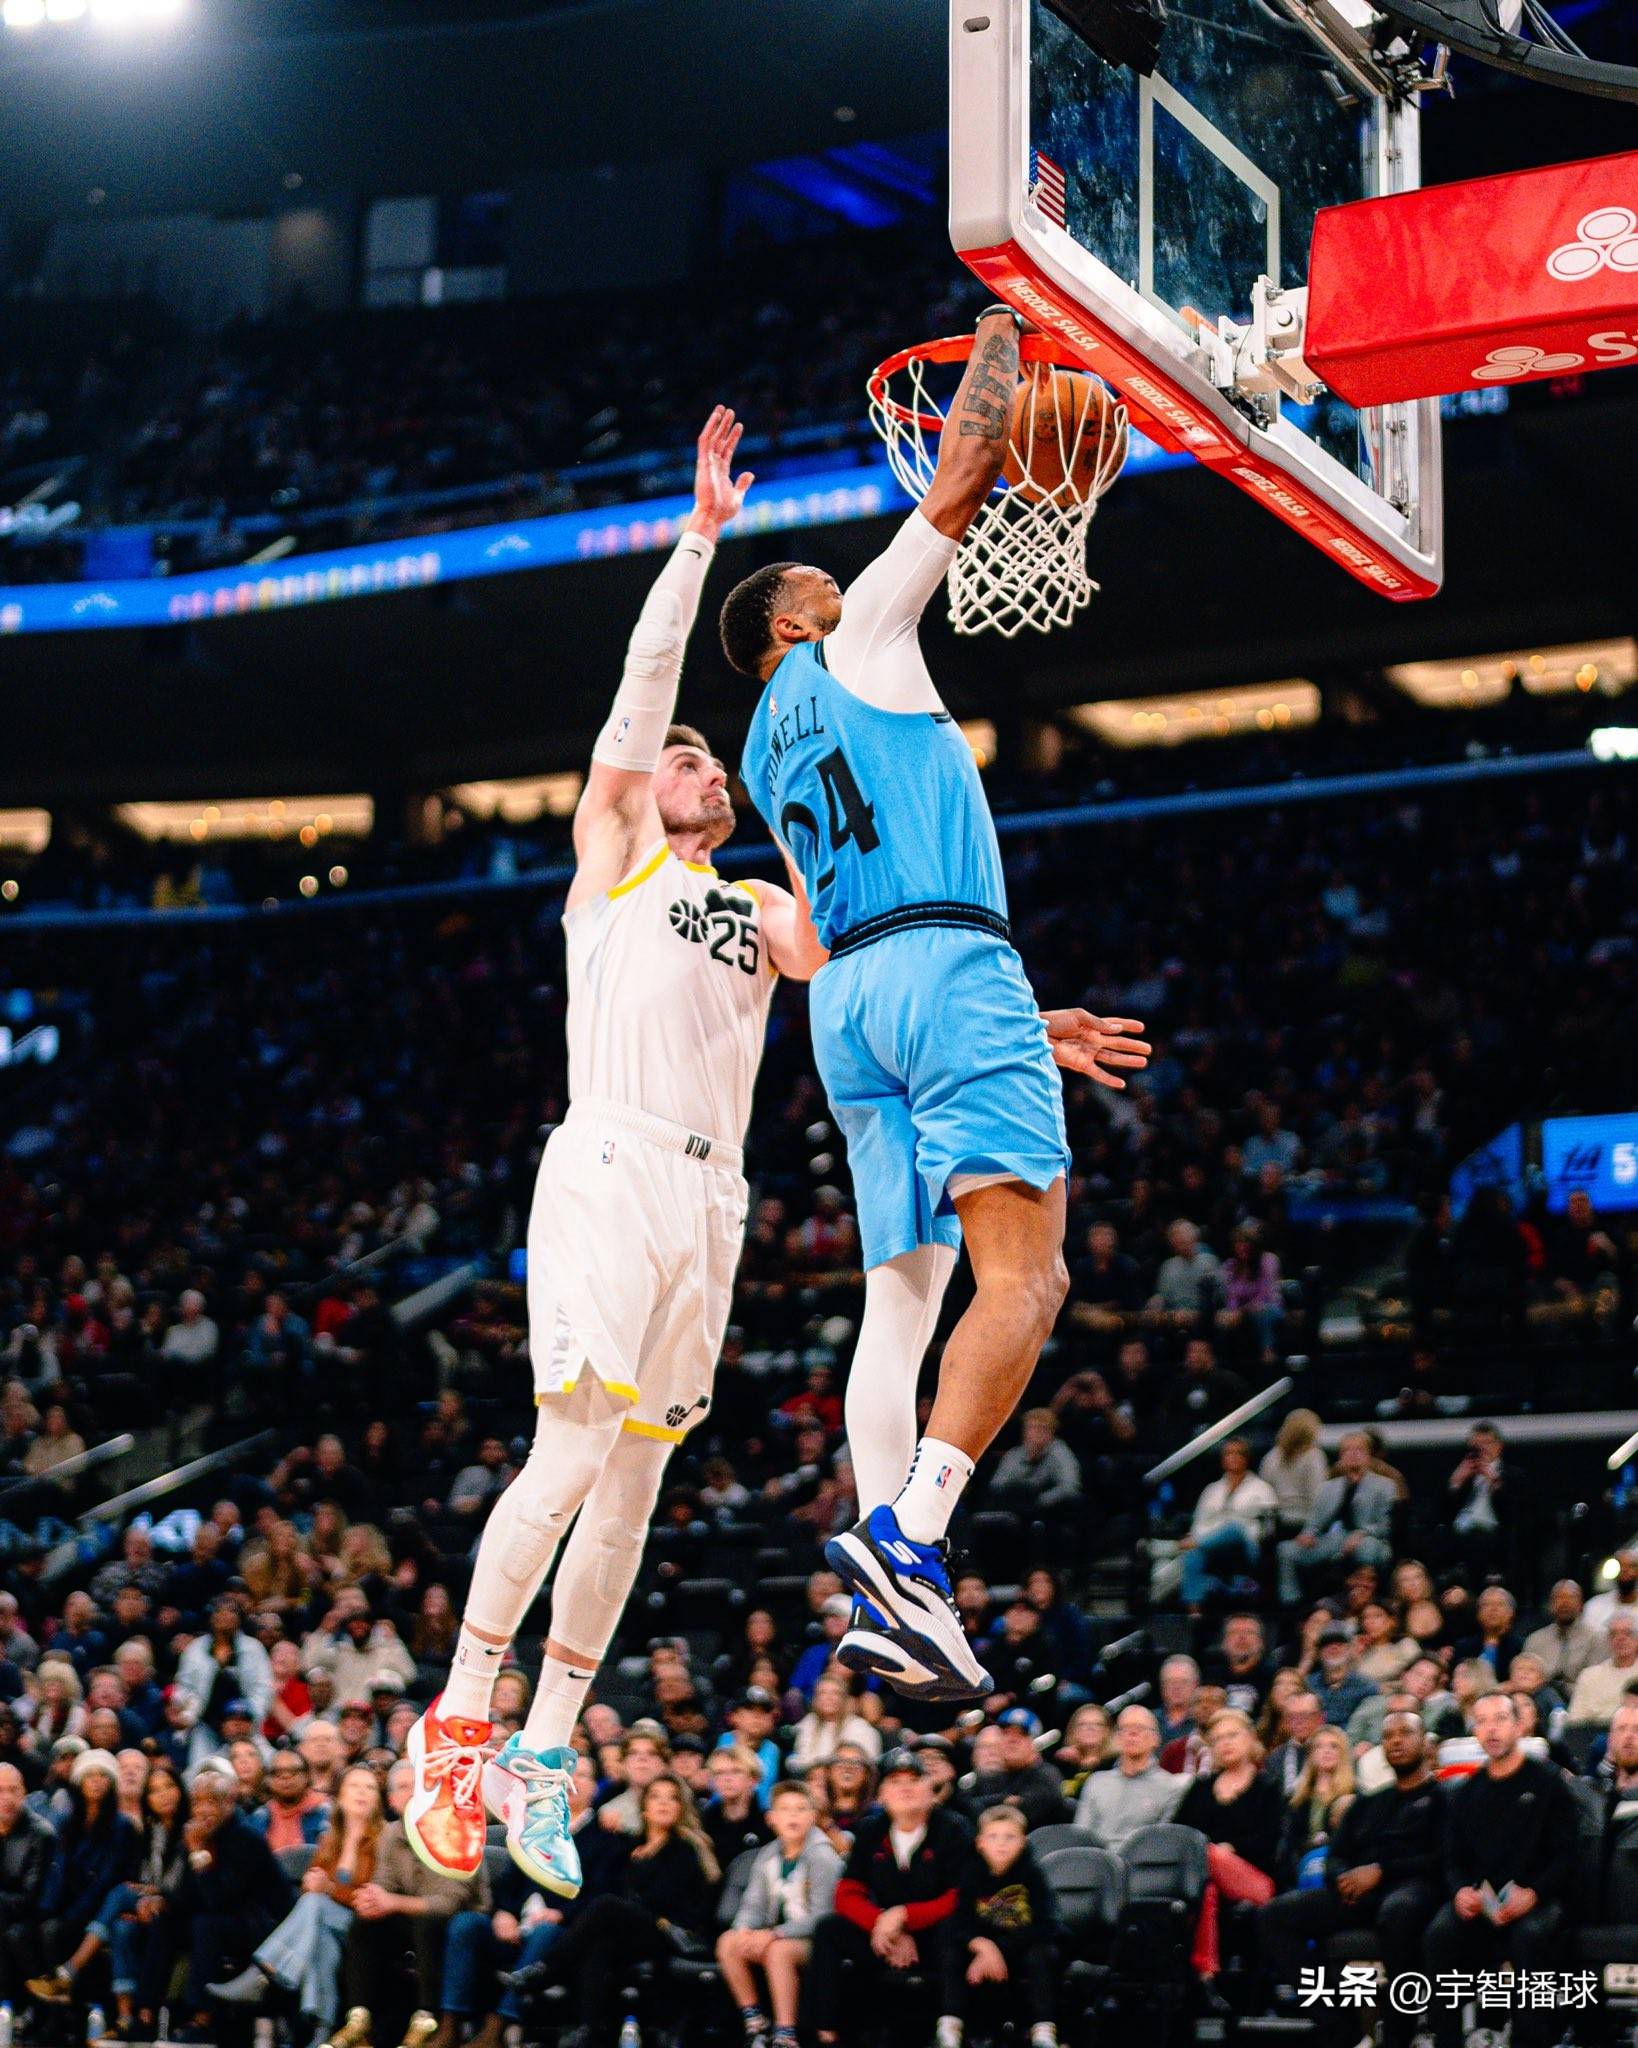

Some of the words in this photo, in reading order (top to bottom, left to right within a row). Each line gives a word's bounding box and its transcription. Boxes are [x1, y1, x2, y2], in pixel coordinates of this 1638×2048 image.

[1007, 281, 1062, 319] HERDEZ
[1053, 319, 1100, 350] SALSA
[1124, 376, 1175, 410] HERDEZ
[1268, 491, 1309, 517] SALSA
[1363, 564, 1402, 589] SALSA
[780, 745, 881, 895] 24
[709, 914, 759, 976] 25
